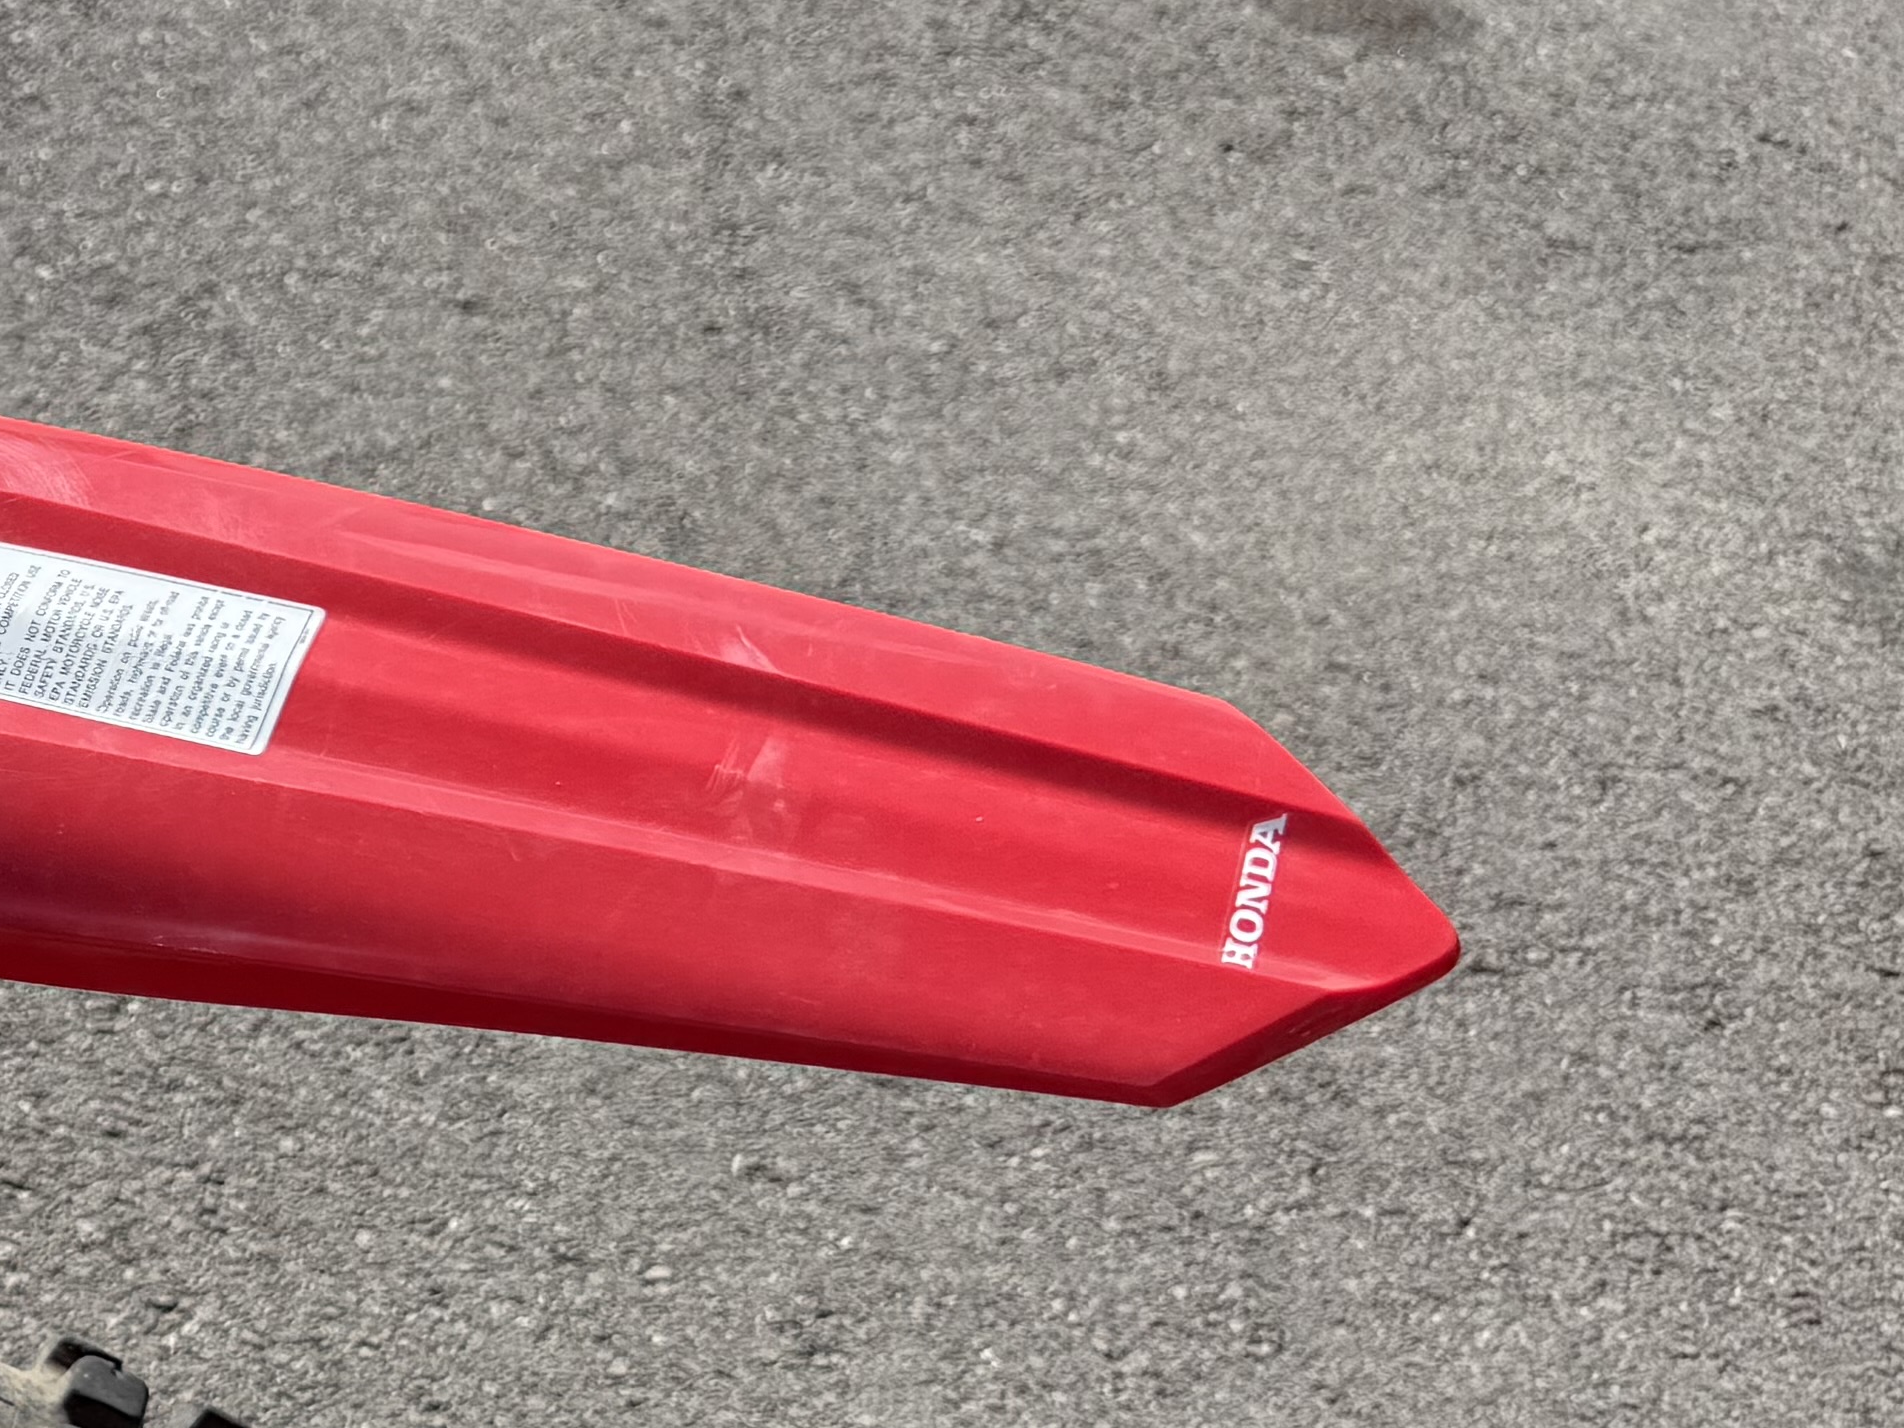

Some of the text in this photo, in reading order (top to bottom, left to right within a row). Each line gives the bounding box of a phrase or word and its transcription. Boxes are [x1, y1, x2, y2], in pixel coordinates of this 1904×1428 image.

[9, 646, 30, 676] DOES
[23, 619, 40, 642] NOT
[17, 649, 47, 694] FEDERAL
[48, 681, 65, 701] EPA
[58, 611, 95, 675] MOTORCYCLE
[1220, 812, 1288, 970] HONDA
